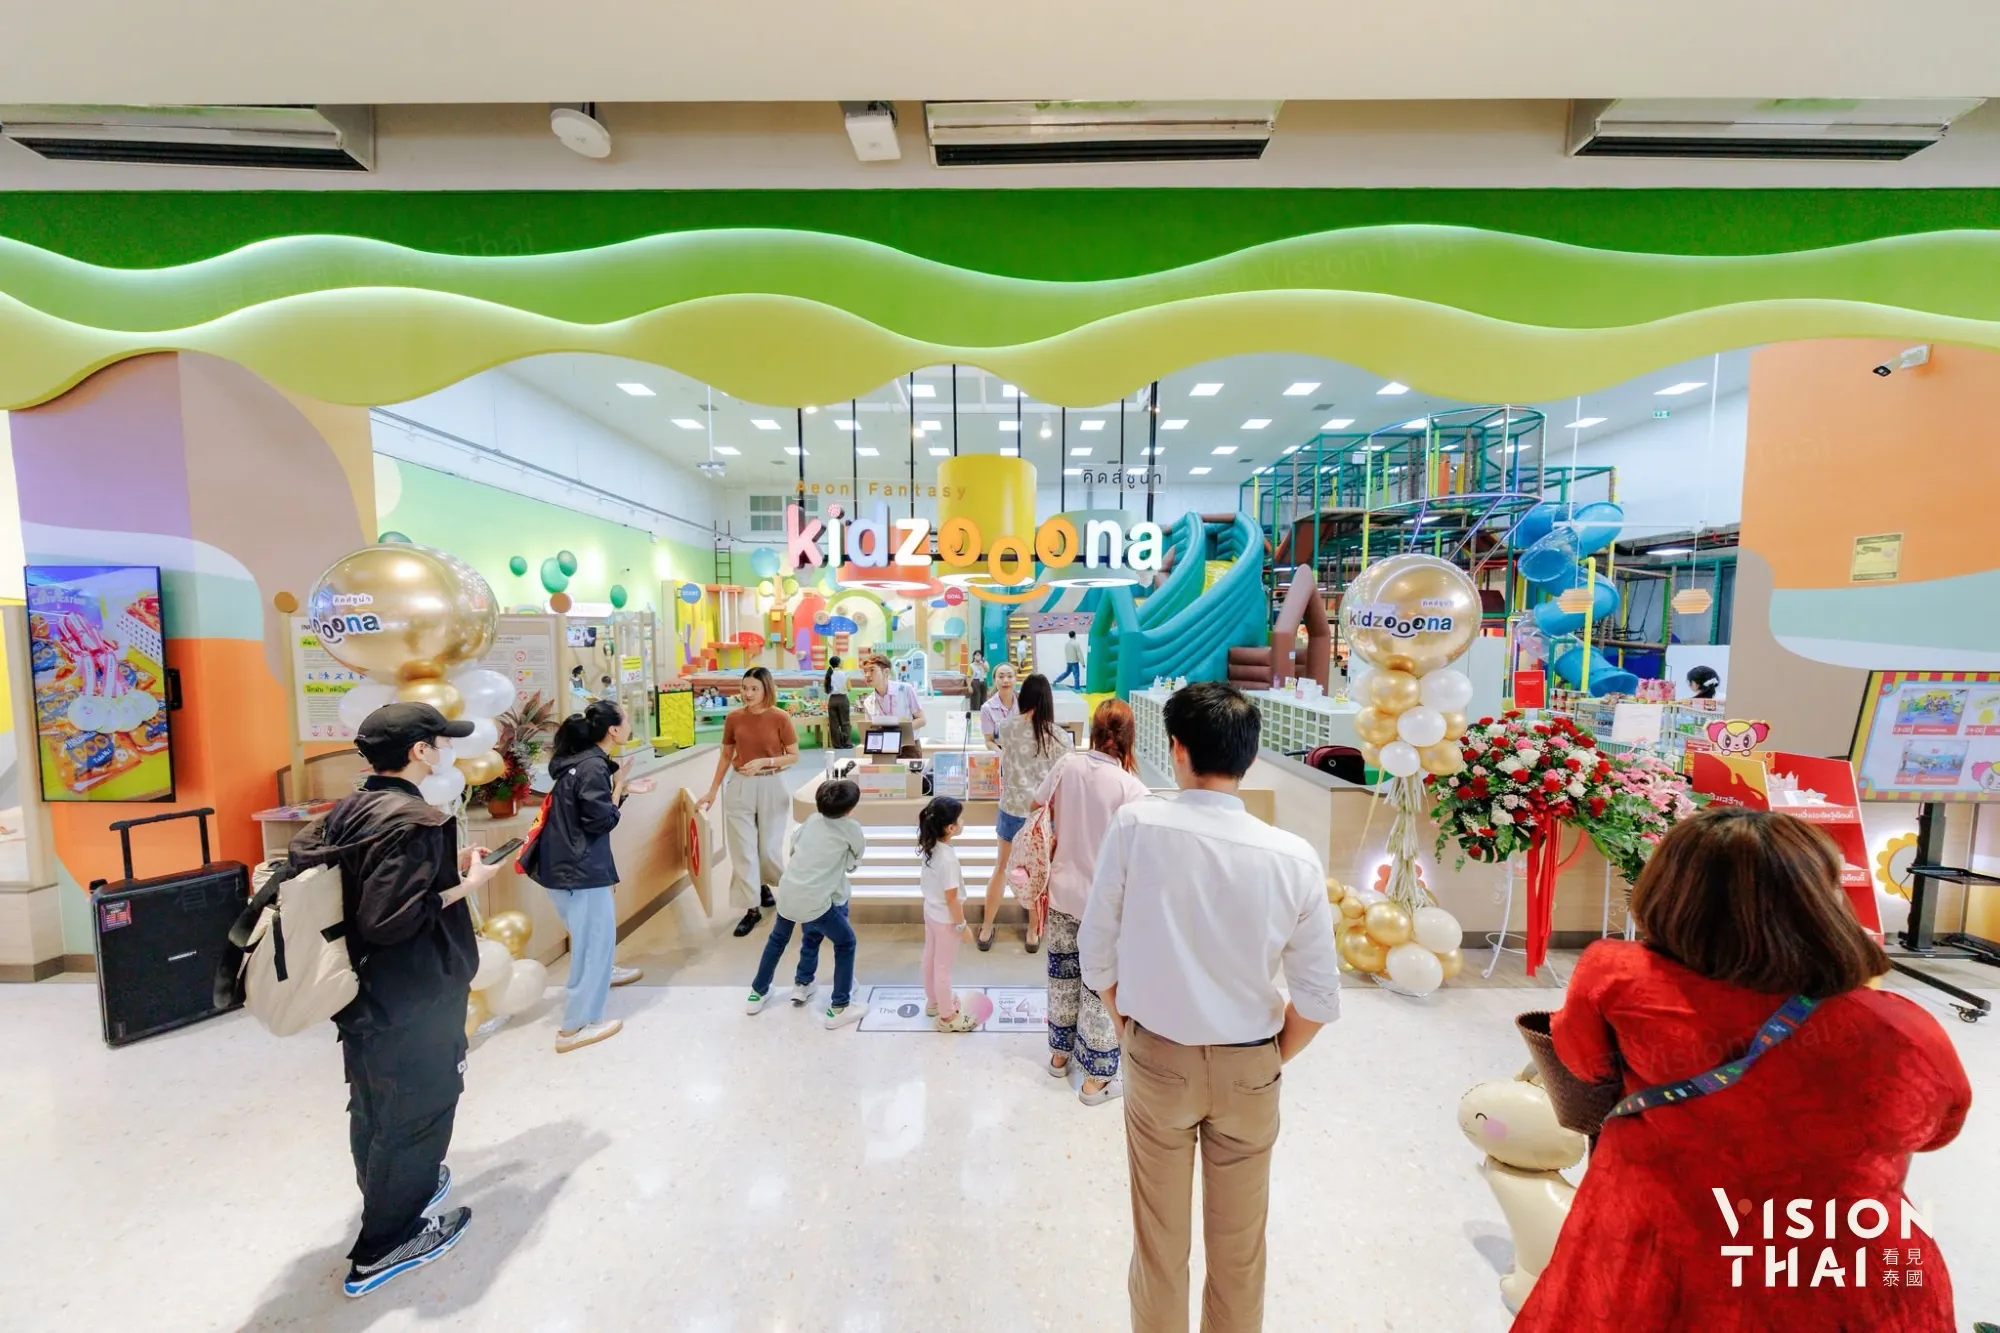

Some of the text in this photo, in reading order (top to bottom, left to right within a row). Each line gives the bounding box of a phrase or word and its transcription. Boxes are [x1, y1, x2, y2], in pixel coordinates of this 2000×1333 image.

[795, 479, 966, 500] Aeon Fantasy
[786, 500, 1163, 587] kidzooona
[311, 614, 381, 639] ooona
[1349, 610, 1452, 634] kidzooona
